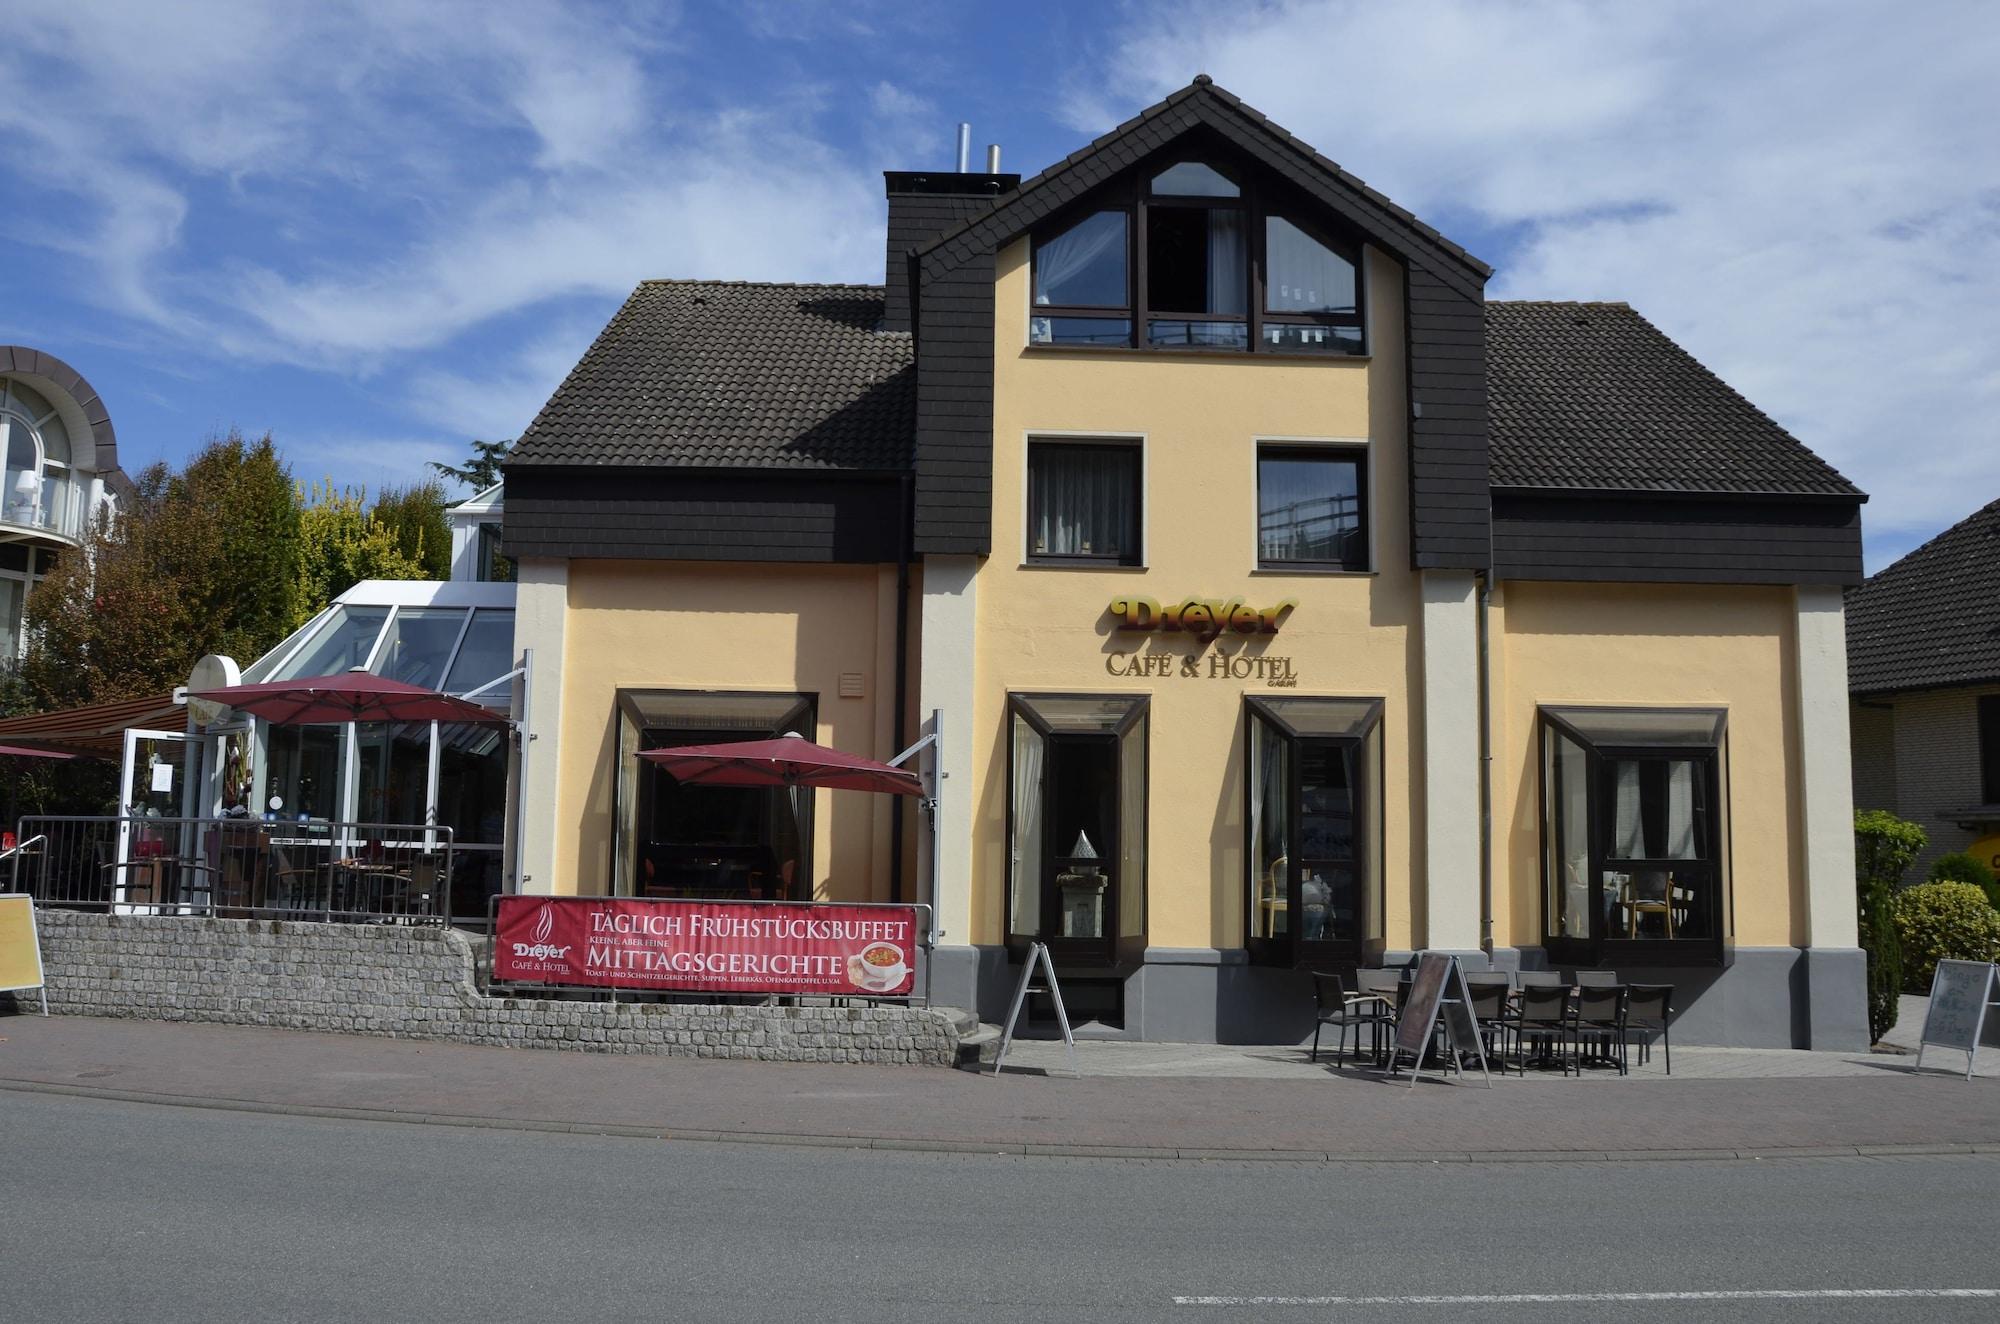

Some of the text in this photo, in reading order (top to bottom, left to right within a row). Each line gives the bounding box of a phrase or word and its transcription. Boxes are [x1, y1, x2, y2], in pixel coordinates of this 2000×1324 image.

[1110, 596, 1299, 643] Dreyer
[1105, 651, 1298, 679] CAFÉ & HOTEL
[590, 909, 909, 941] TÄGLICH FRÜHSTÜCKSBUFFET
[512, 943, 572, 961] Dreyer
[622, 938, 643, 946] ABER
[511, 960, 570, 972] CAFÉ & HOTEL
[586, 945, 842, 975] MITTAGSGERICHTE
